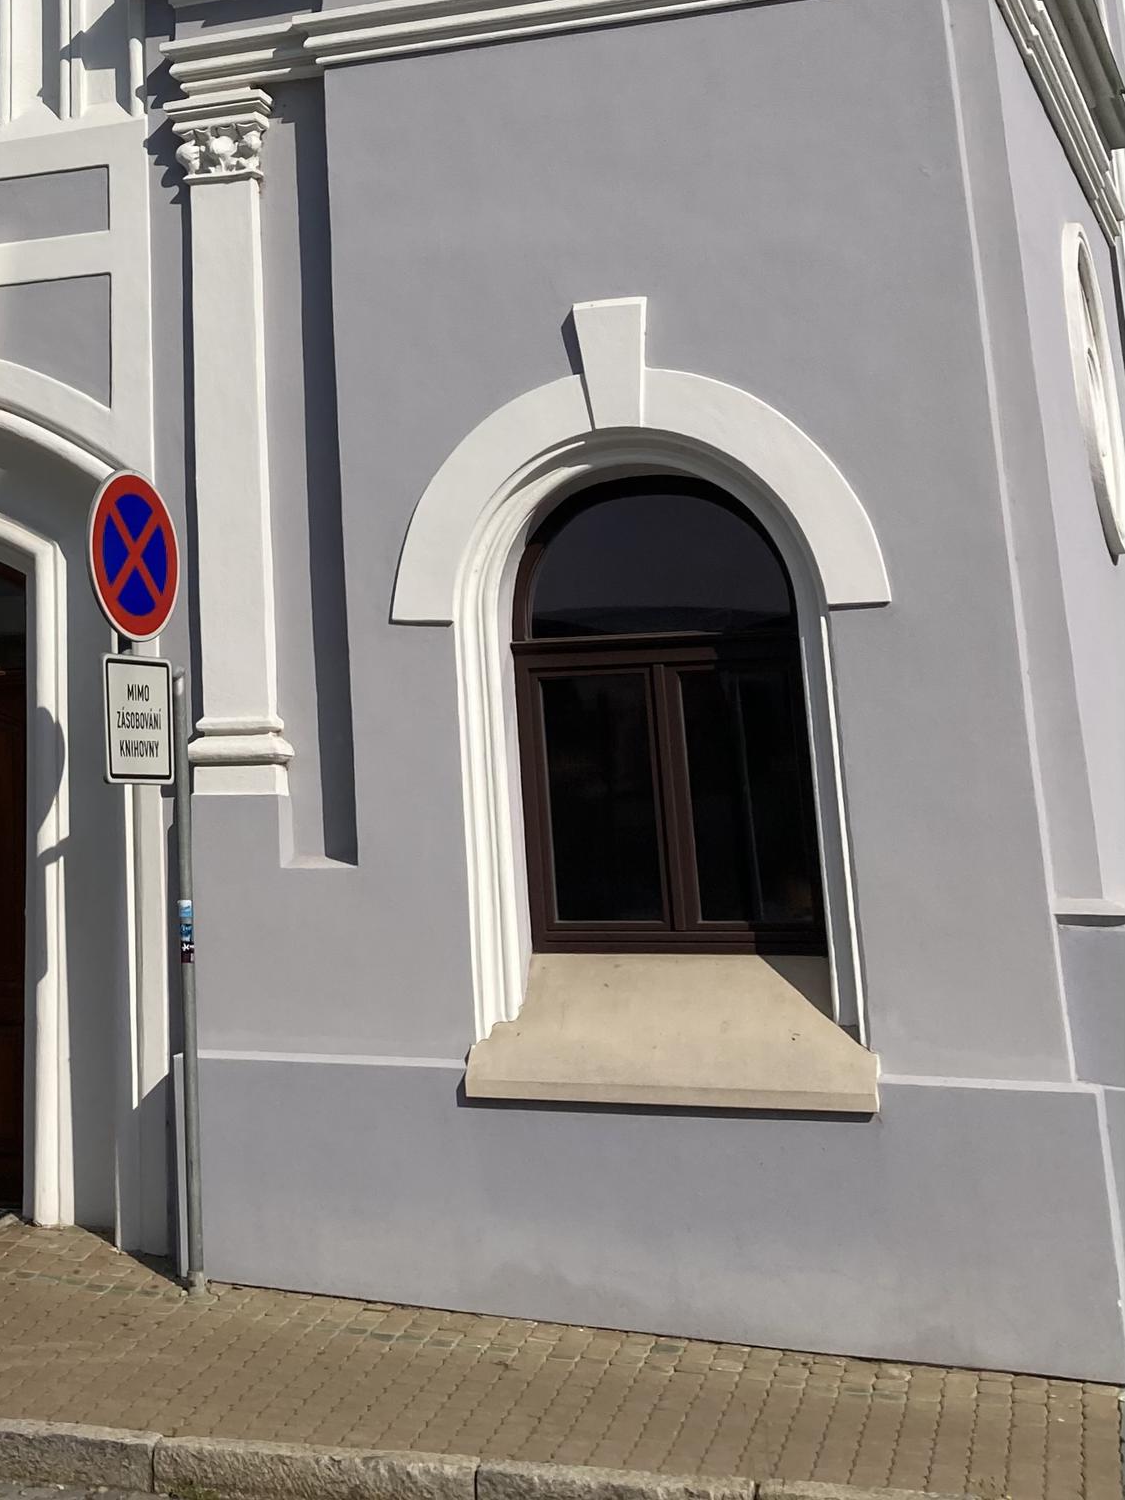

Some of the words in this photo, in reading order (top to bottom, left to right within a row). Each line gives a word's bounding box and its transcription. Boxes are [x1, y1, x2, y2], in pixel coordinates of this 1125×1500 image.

[127, 683, 150, 702] MIMO
[116, 706, 162, 730] ZÁSOBOVÁNÍ
[119, 739, 160, 758] KNIHOVNY
